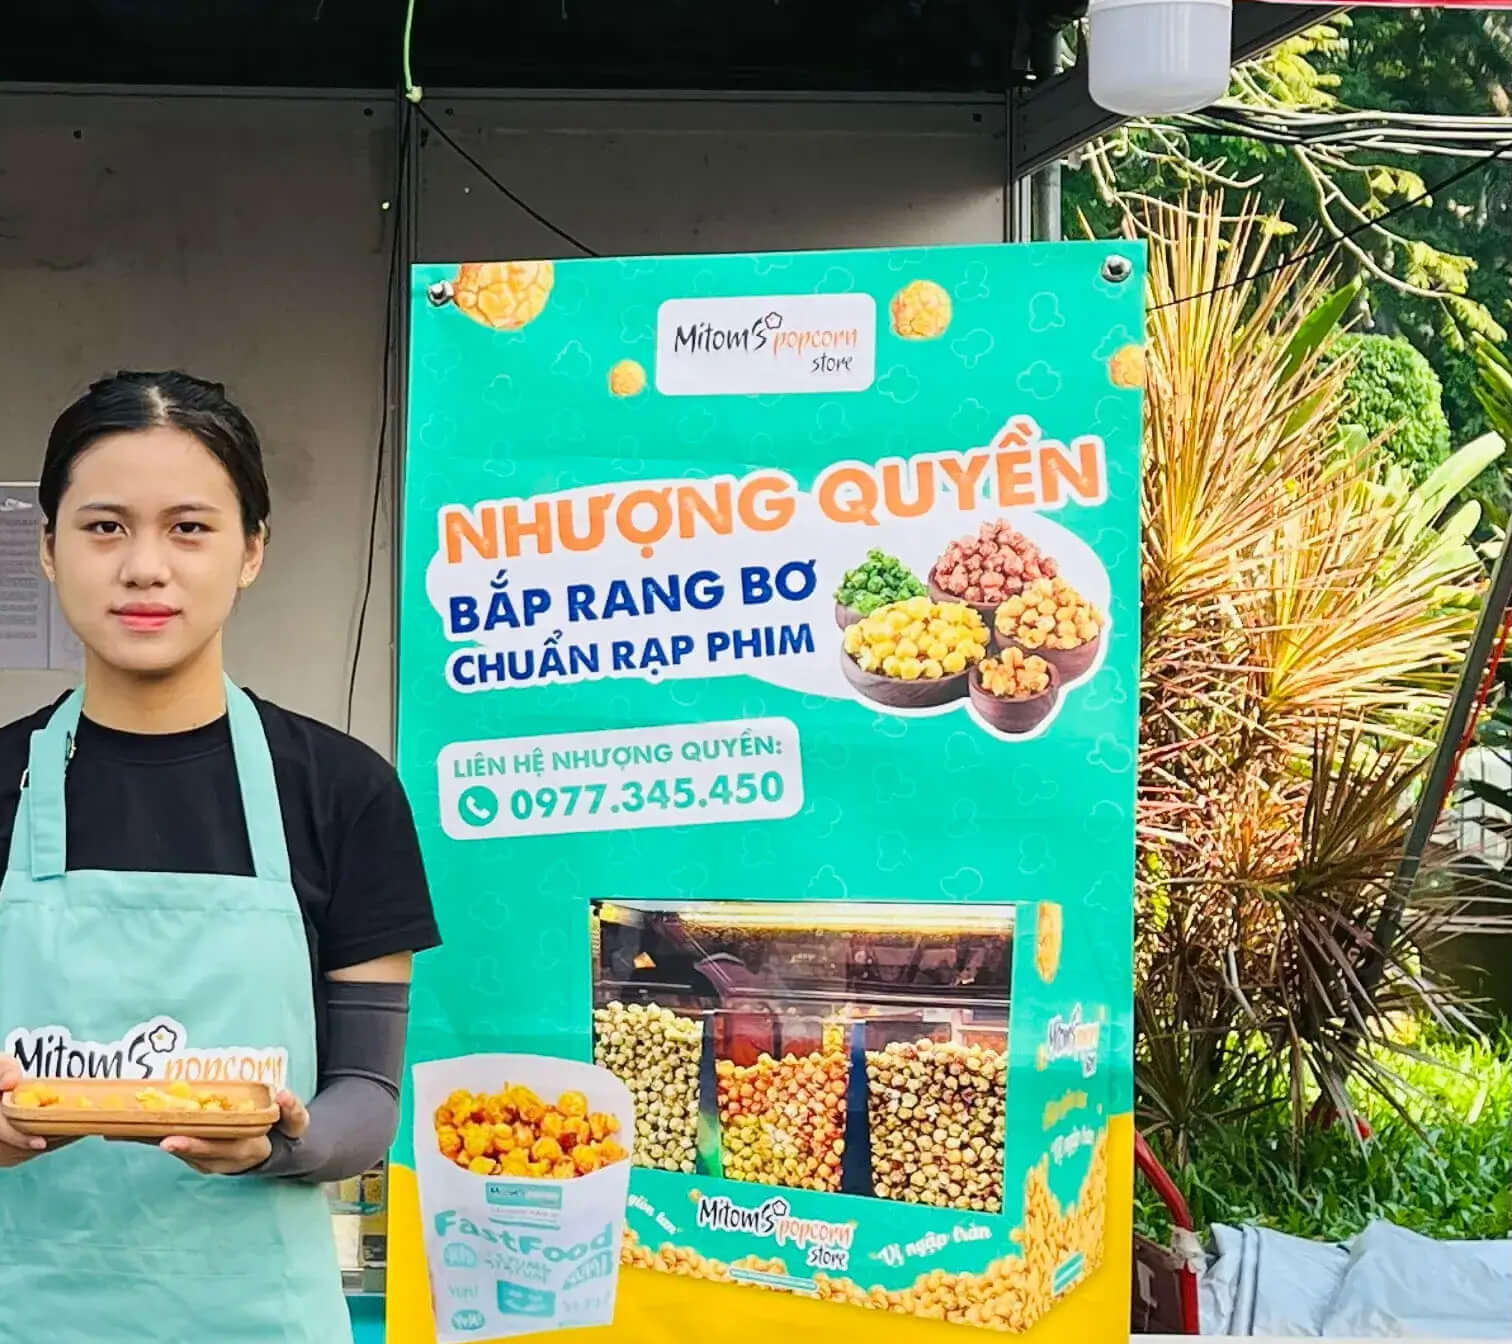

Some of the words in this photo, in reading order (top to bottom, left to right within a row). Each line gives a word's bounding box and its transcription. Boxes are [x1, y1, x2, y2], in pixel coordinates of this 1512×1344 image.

[772, 328, 859, 357] popcorn
[811, 352, 853, 374] store
[444, 476, 797, 564] NHƯỢNG
[817, 422, 1102, 527] QUYỀN
[449, 568, 551, 634] BẮP
[567, 570, 725, 623] RANG
[741, 559, 817, 606] BƠ
[452, 629, 600, 686] CHUẨN
[611, 634, 695, 676] RẠP
[706, 622, 815, 662] PHIM
[453, 751, 506, 779] LIÊN
[513, 747, 545, 775] HỆ
[552, 742, 674, 772] NHƯỢNG
[510, 770, 785, 822] 0977.345.450
